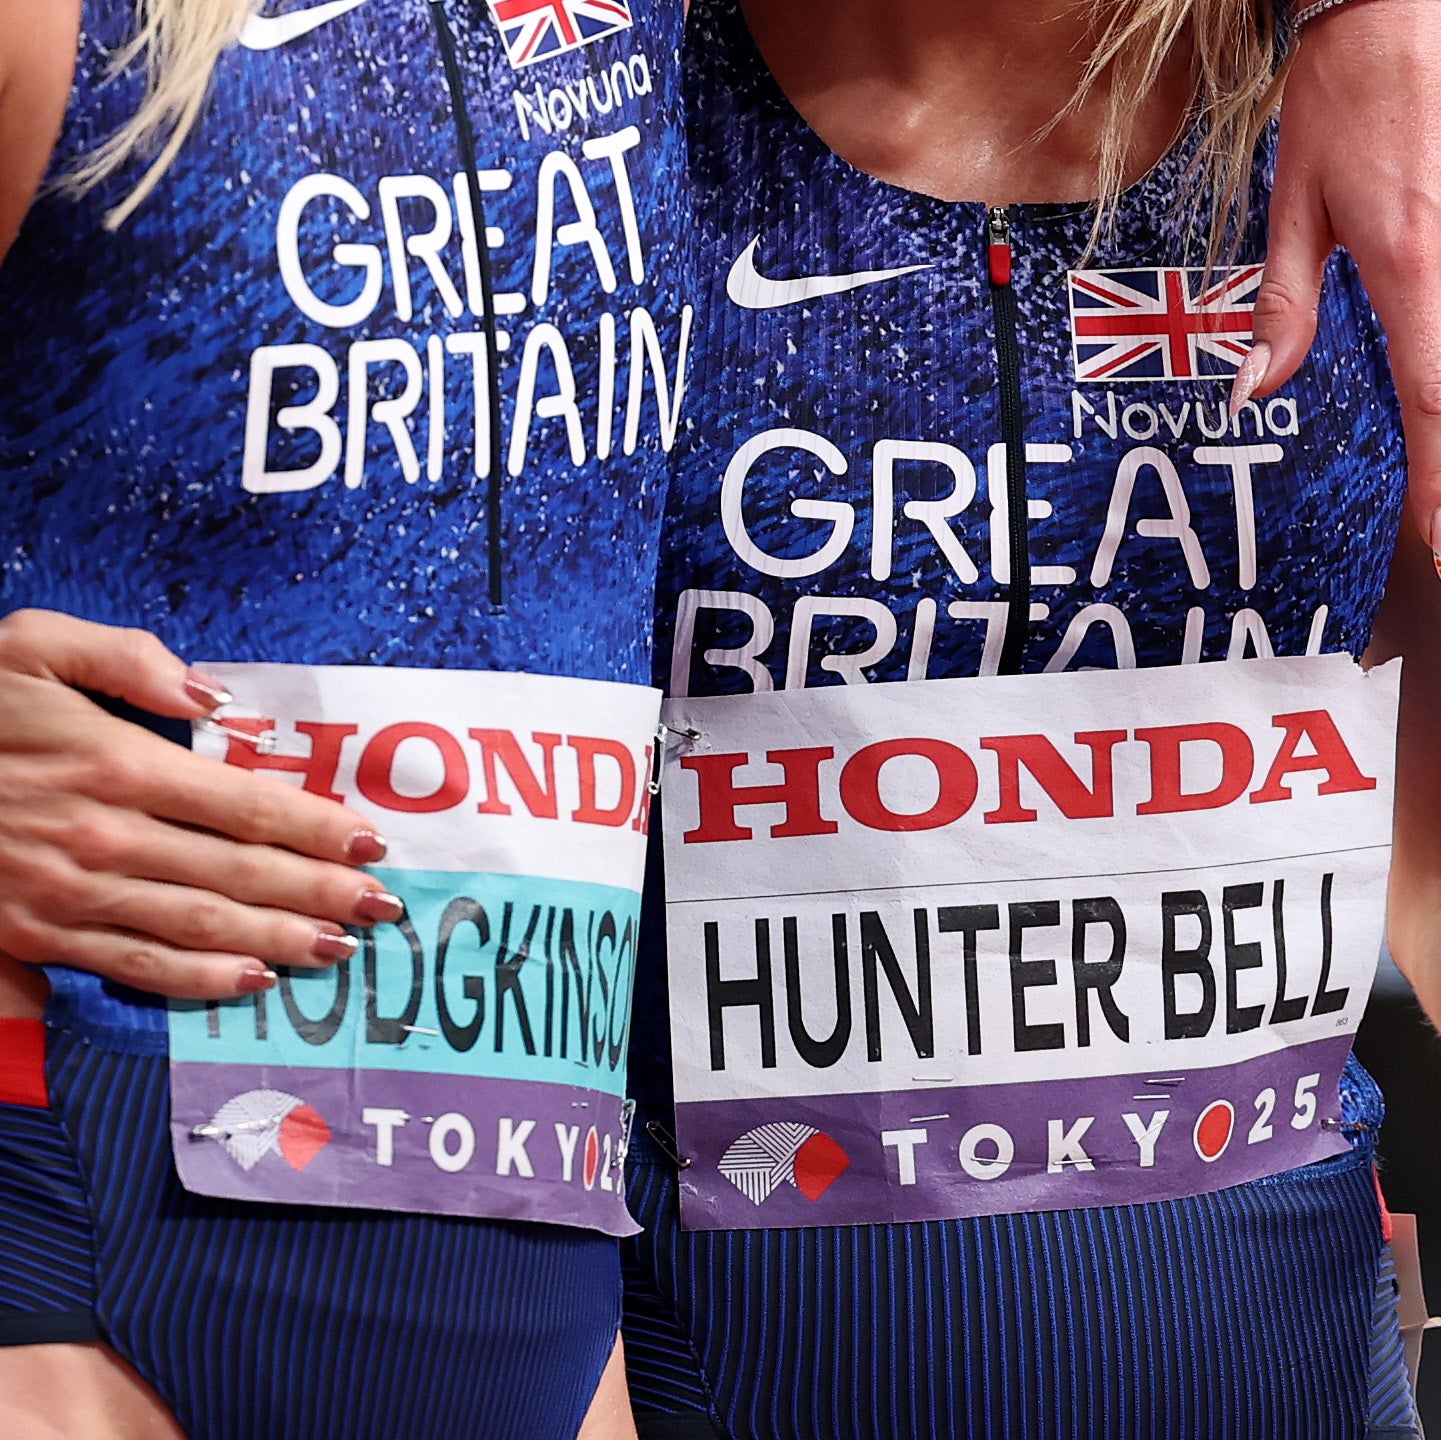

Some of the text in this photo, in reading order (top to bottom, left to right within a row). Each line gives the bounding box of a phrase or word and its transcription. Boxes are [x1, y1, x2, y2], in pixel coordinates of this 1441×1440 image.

[513, 53, 652, 141] Novuna
[276, 126, 640, 328] GREAT
[242, 304, 693, 494] BRITAIN
[1071, 397, 1300, 440] Novuna
[720, 428, 1284, 591] GREAT
[681, 708, 1377, 845] HONDA
[207, 896, 637, 1072] ODGKINSO
[703, 872, 1350, 1072] HUNTER BELL
